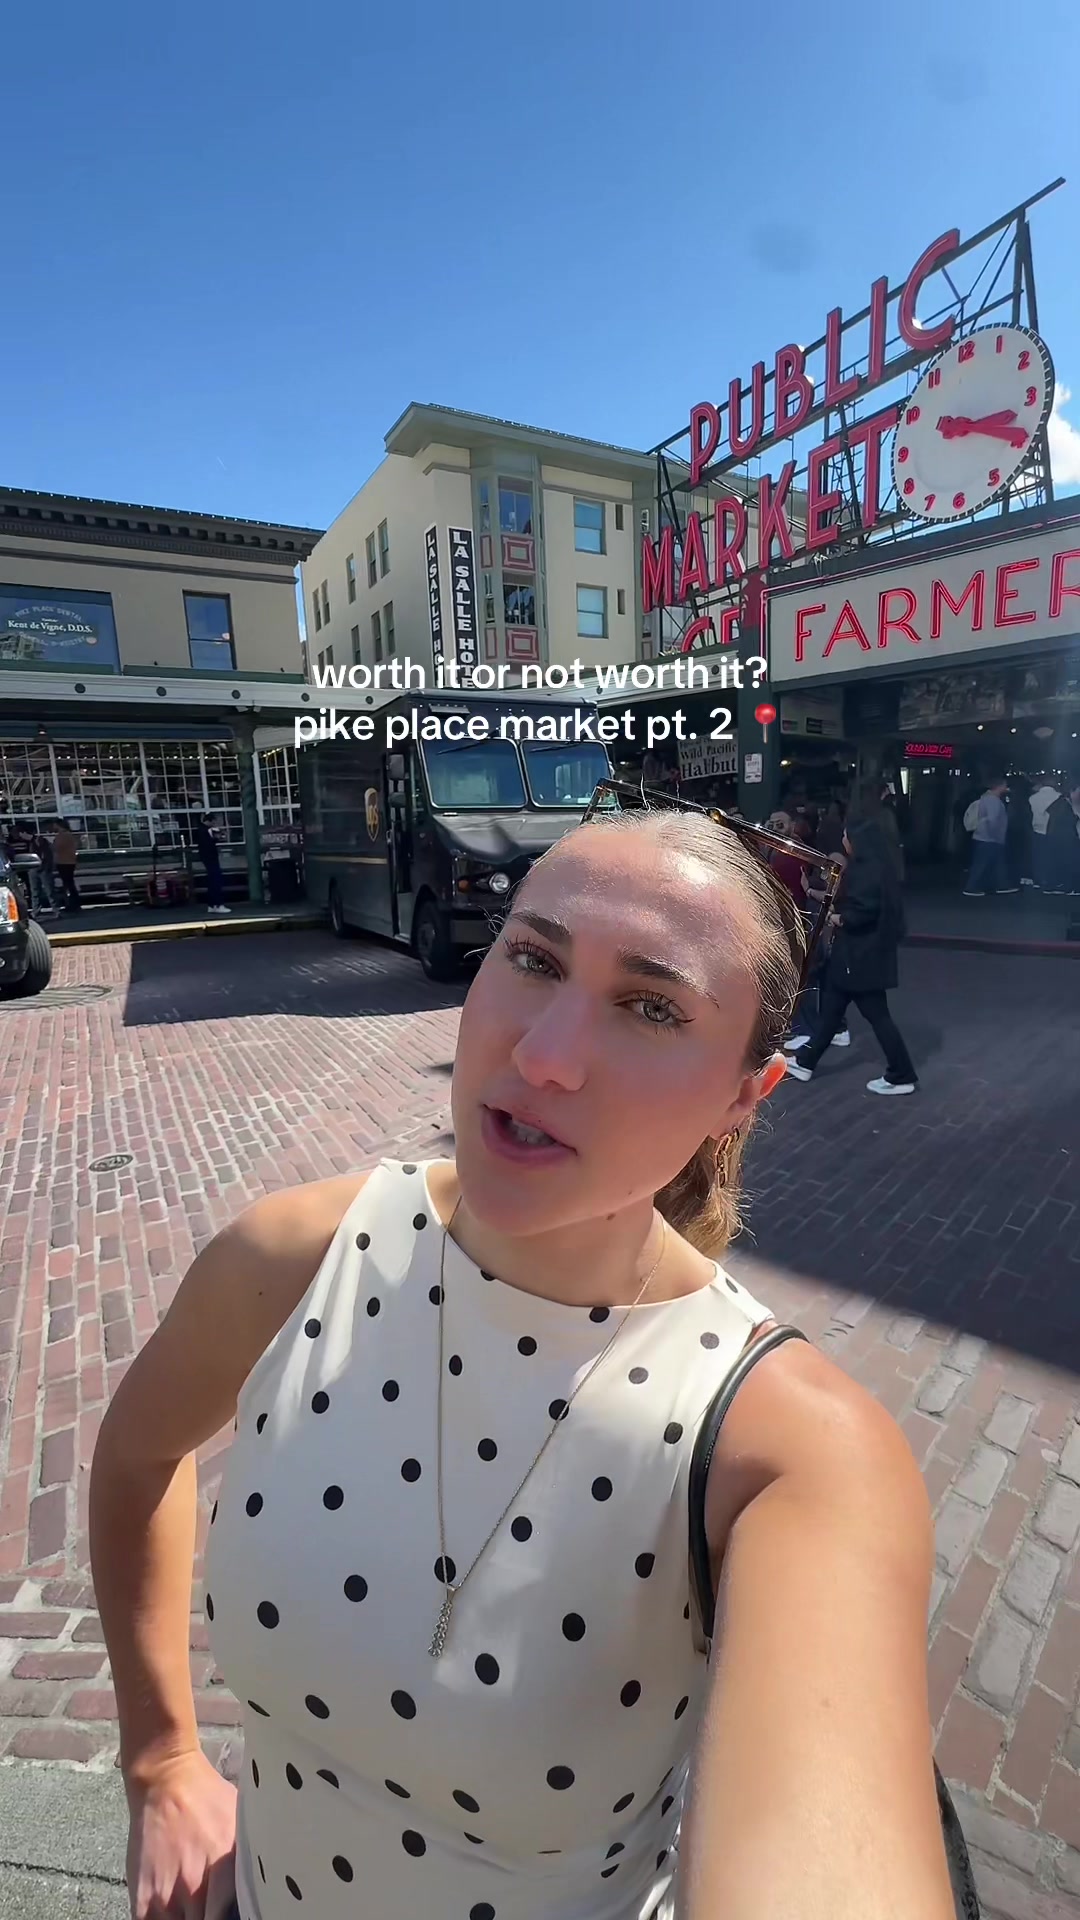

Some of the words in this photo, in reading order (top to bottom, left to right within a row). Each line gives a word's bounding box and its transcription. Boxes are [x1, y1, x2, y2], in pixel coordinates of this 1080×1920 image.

[958, 341, 975, 363] 12
[996, 335, 1003, 353] 1
[690, 228, 960, 486] PUBLIC
[1018, 351, 1030, 371] 2
[928, 368, 941, 389] 11
[1024, 386, 1037, 406] 3
[906, 406, 920, 425] 10
[897, 446, 909, 463] 9
[903, 478, 915, 495] 8
[987, 468, 1000, 487] 5
[642, 408, 898, 613] MARKET
[924, 494, 936, 512] 7
[952, 492, 966, 510] 6
[427, 534, 436, 562] LA
[453, 531, 469, 559] LA
[429, 563, 441, 632] SALLE
[455, 565, 472, 631] SALLE
[794, 548, 1080, 662] FARMER
[8, 620, 28, 629] Kent
[30, 621, 40, 630] de
[68, 624, 93, 633] D.D.S.
[681, 746, 702, 760] Wild
[706, 742, 737, 756] Pacific
